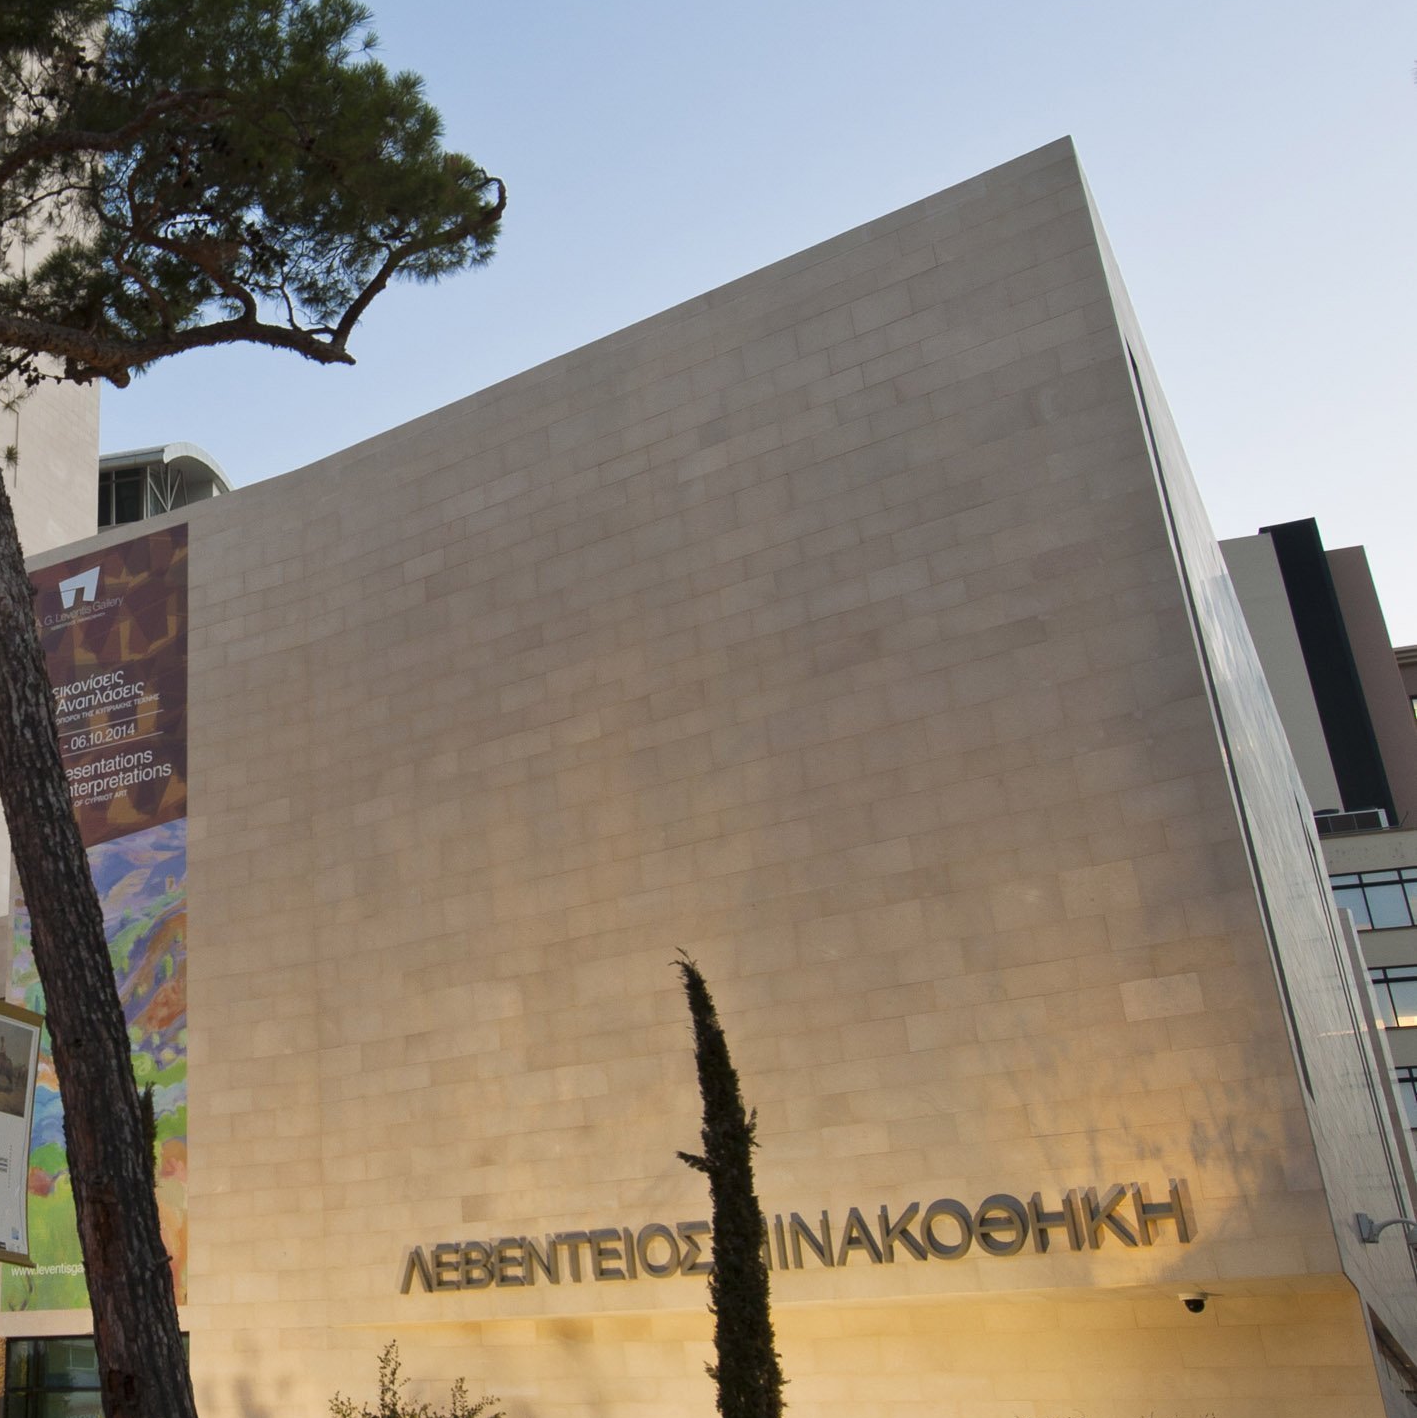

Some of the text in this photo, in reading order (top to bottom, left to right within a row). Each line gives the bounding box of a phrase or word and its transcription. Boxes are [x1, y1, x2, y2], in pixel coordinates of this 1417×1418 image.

[55, 605, 92, 623] Leventis
[93, 596, 124, 612] Gallery
[53, 670, 124, 700] εικονίσεις
[56, 681, 144, 715] Αναπλάσεις
[71, 722, 135, 751] 06.10.2014
[65, 750, 153, 782] esentations
[70, 763, 172, 797] terpretations
[84, 792, 113, 806] CYPRIOT
[114, 789, 128, 799] ART
[11, 1262, 85, 1277] www.leventisga
